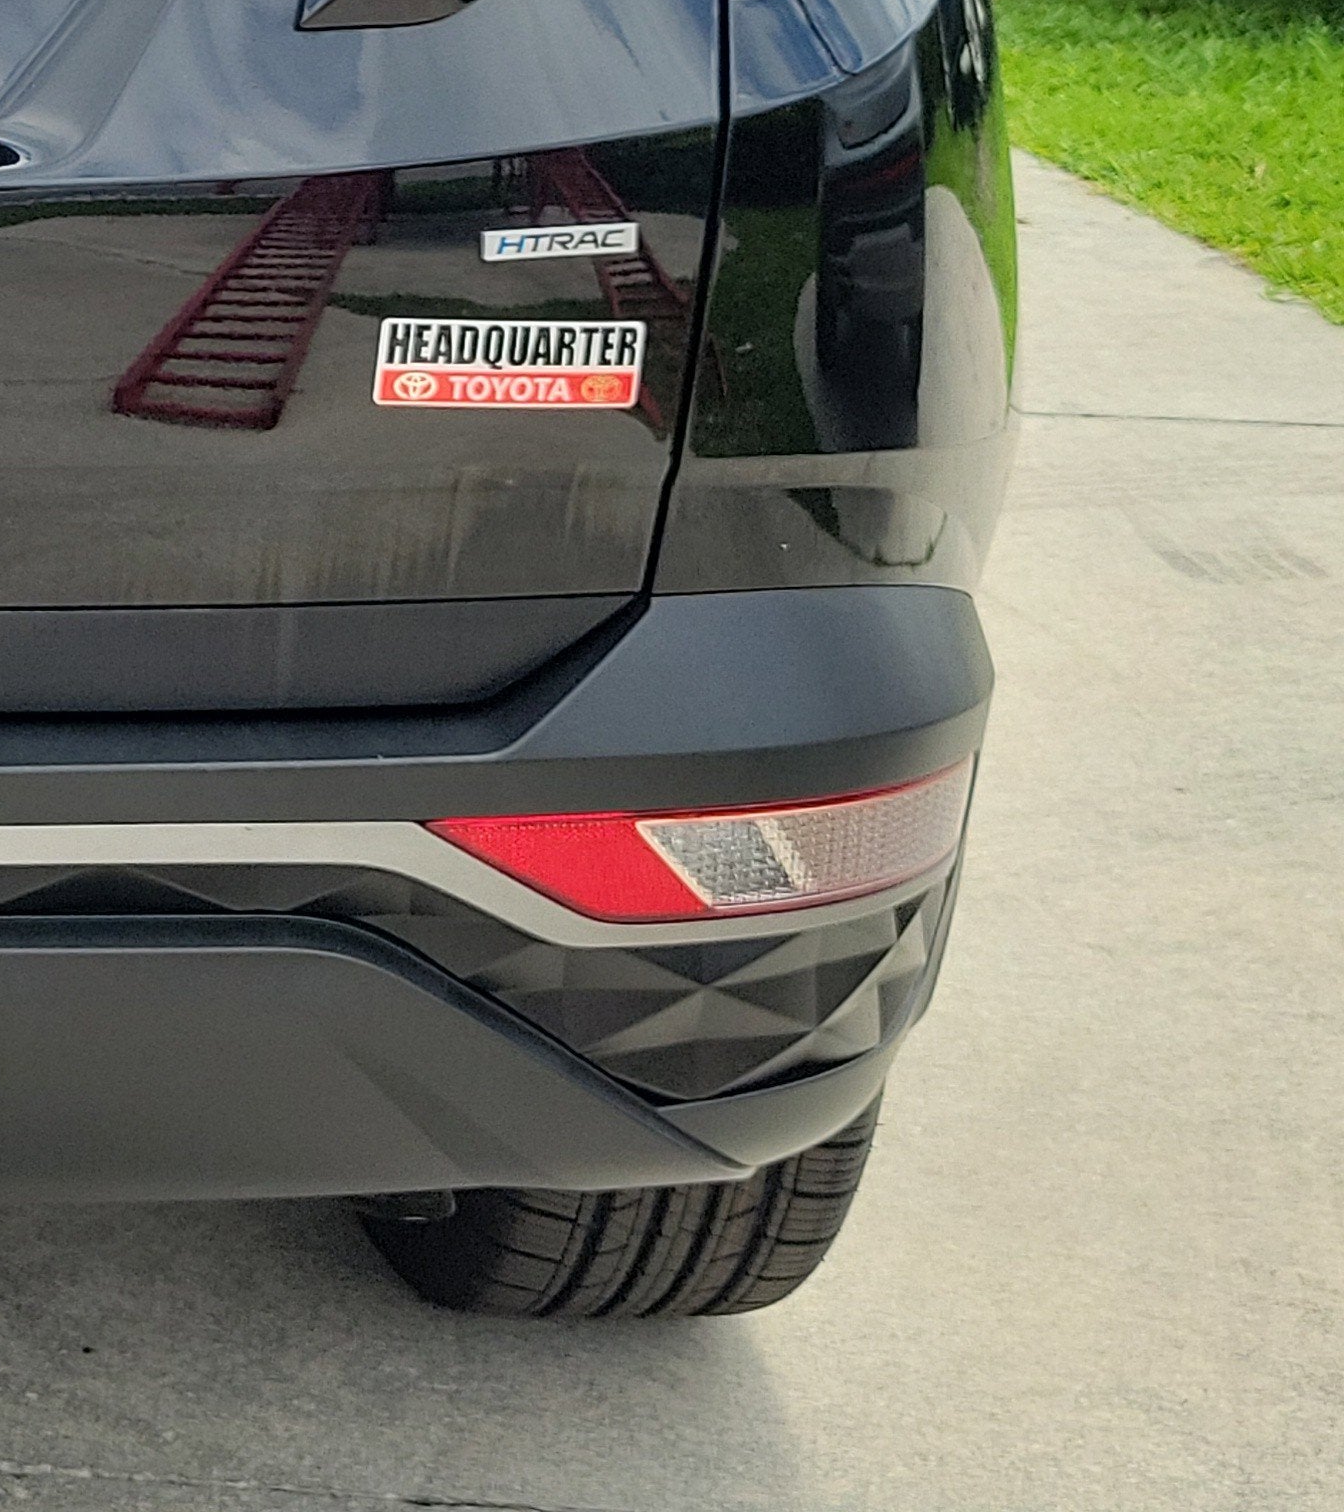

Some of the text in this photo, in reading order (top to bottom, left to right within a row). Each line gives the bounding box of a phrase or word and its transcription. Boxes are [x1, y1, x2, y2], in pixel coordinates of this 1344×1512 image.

[496, 229, 625, 255] HTRAC
[386, 323, 638, 369] HEADQUARTER
[449, 375, 572, 403] TOYOTA
